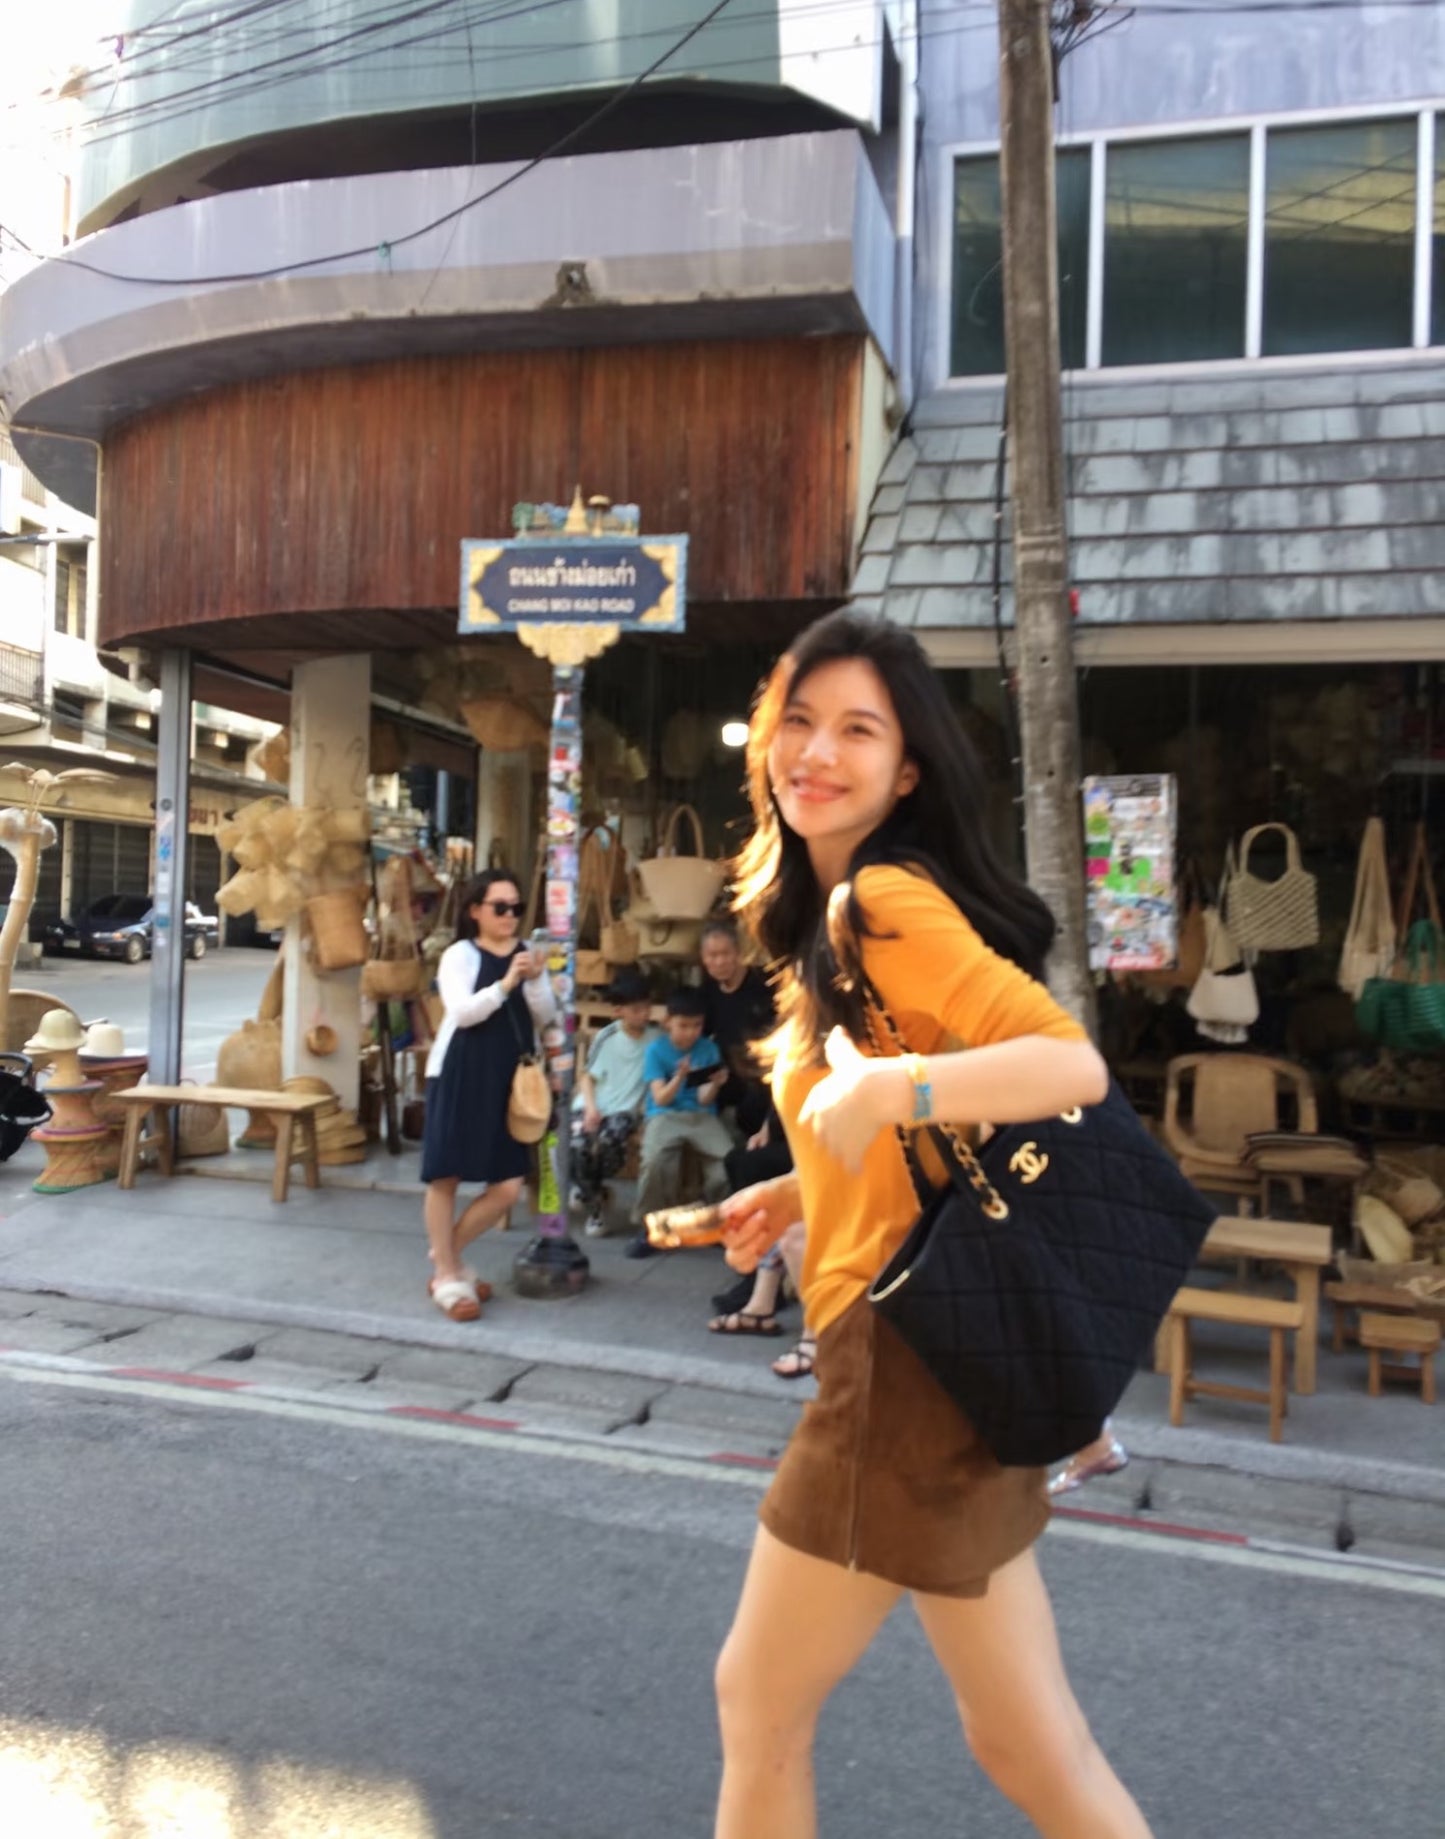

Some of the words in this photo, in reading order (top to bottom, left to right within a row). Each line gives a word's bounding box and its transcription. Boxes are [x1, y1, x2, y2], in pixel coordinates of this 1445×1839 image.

[507, 598, 548, 613] CHANG
[550, 598, 571, 612] MOI
[600, 598, 635, 613] ROAD
